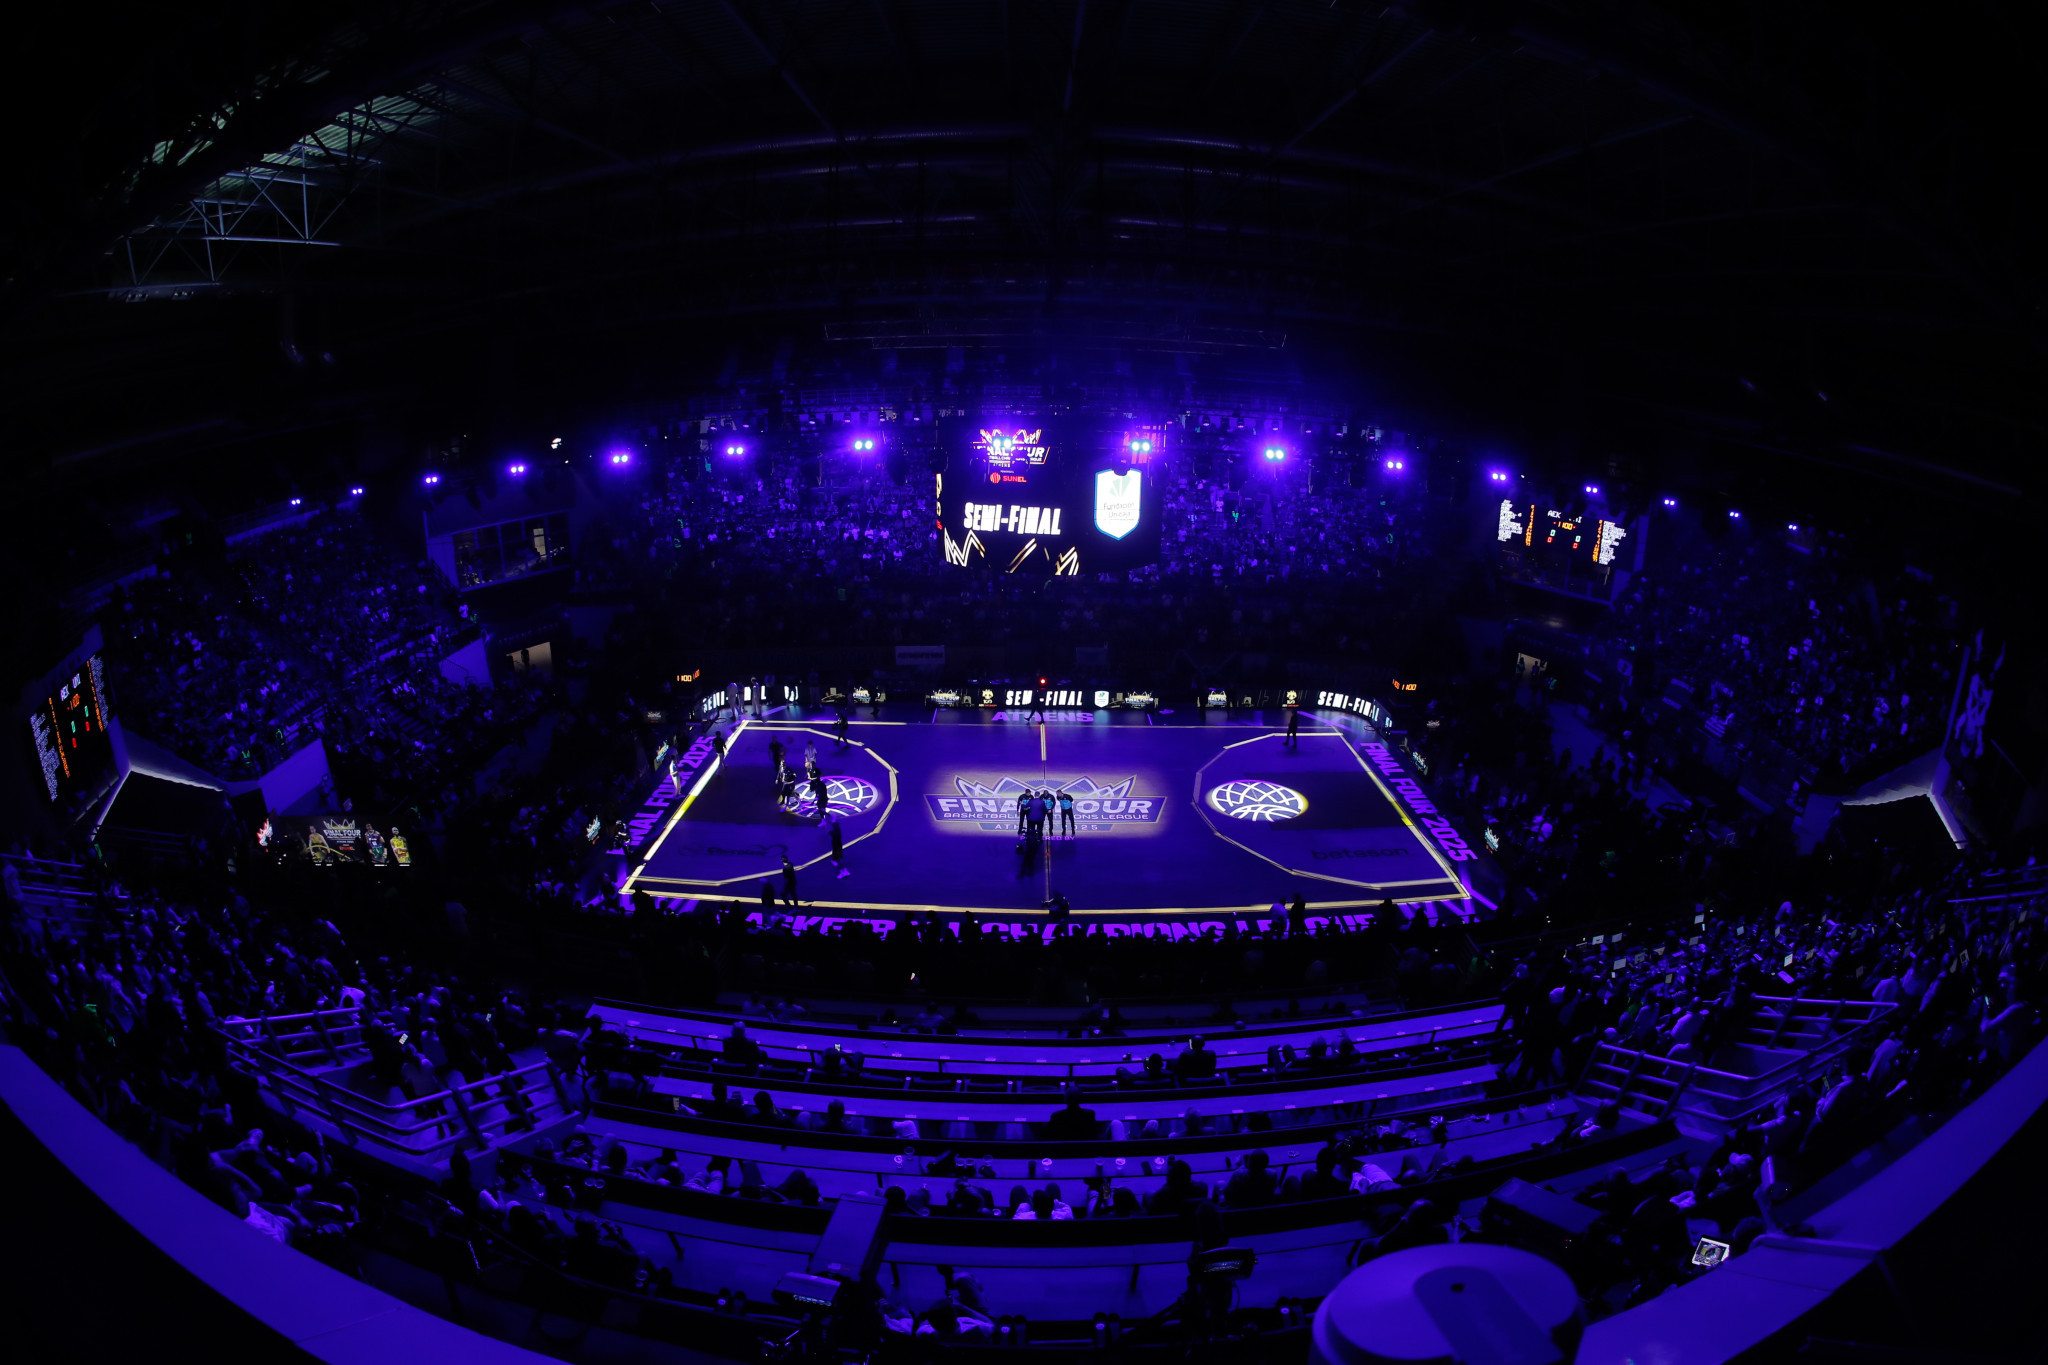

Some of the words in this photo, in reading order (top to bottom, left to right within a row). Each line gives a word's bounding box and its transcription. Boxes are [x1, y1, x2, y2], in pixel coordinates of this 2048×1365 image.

[1002, 475, 1027, 483] SUNEL
[963, 502, 1061, 535] SEMI-FINAL
[1005, 690, 1083, 706] SEM-FINAL
[1317, 691, 1380, 722] SEMI-FINAL
[937, 798, 1019, 813] FINA
[1359, 742, 1405, 777] FINAL
[1388, 778, 1439, 814] FOUR
[1420, 815, 1478, 861] 2025
[1309, 848, 1409, 860] betsson
